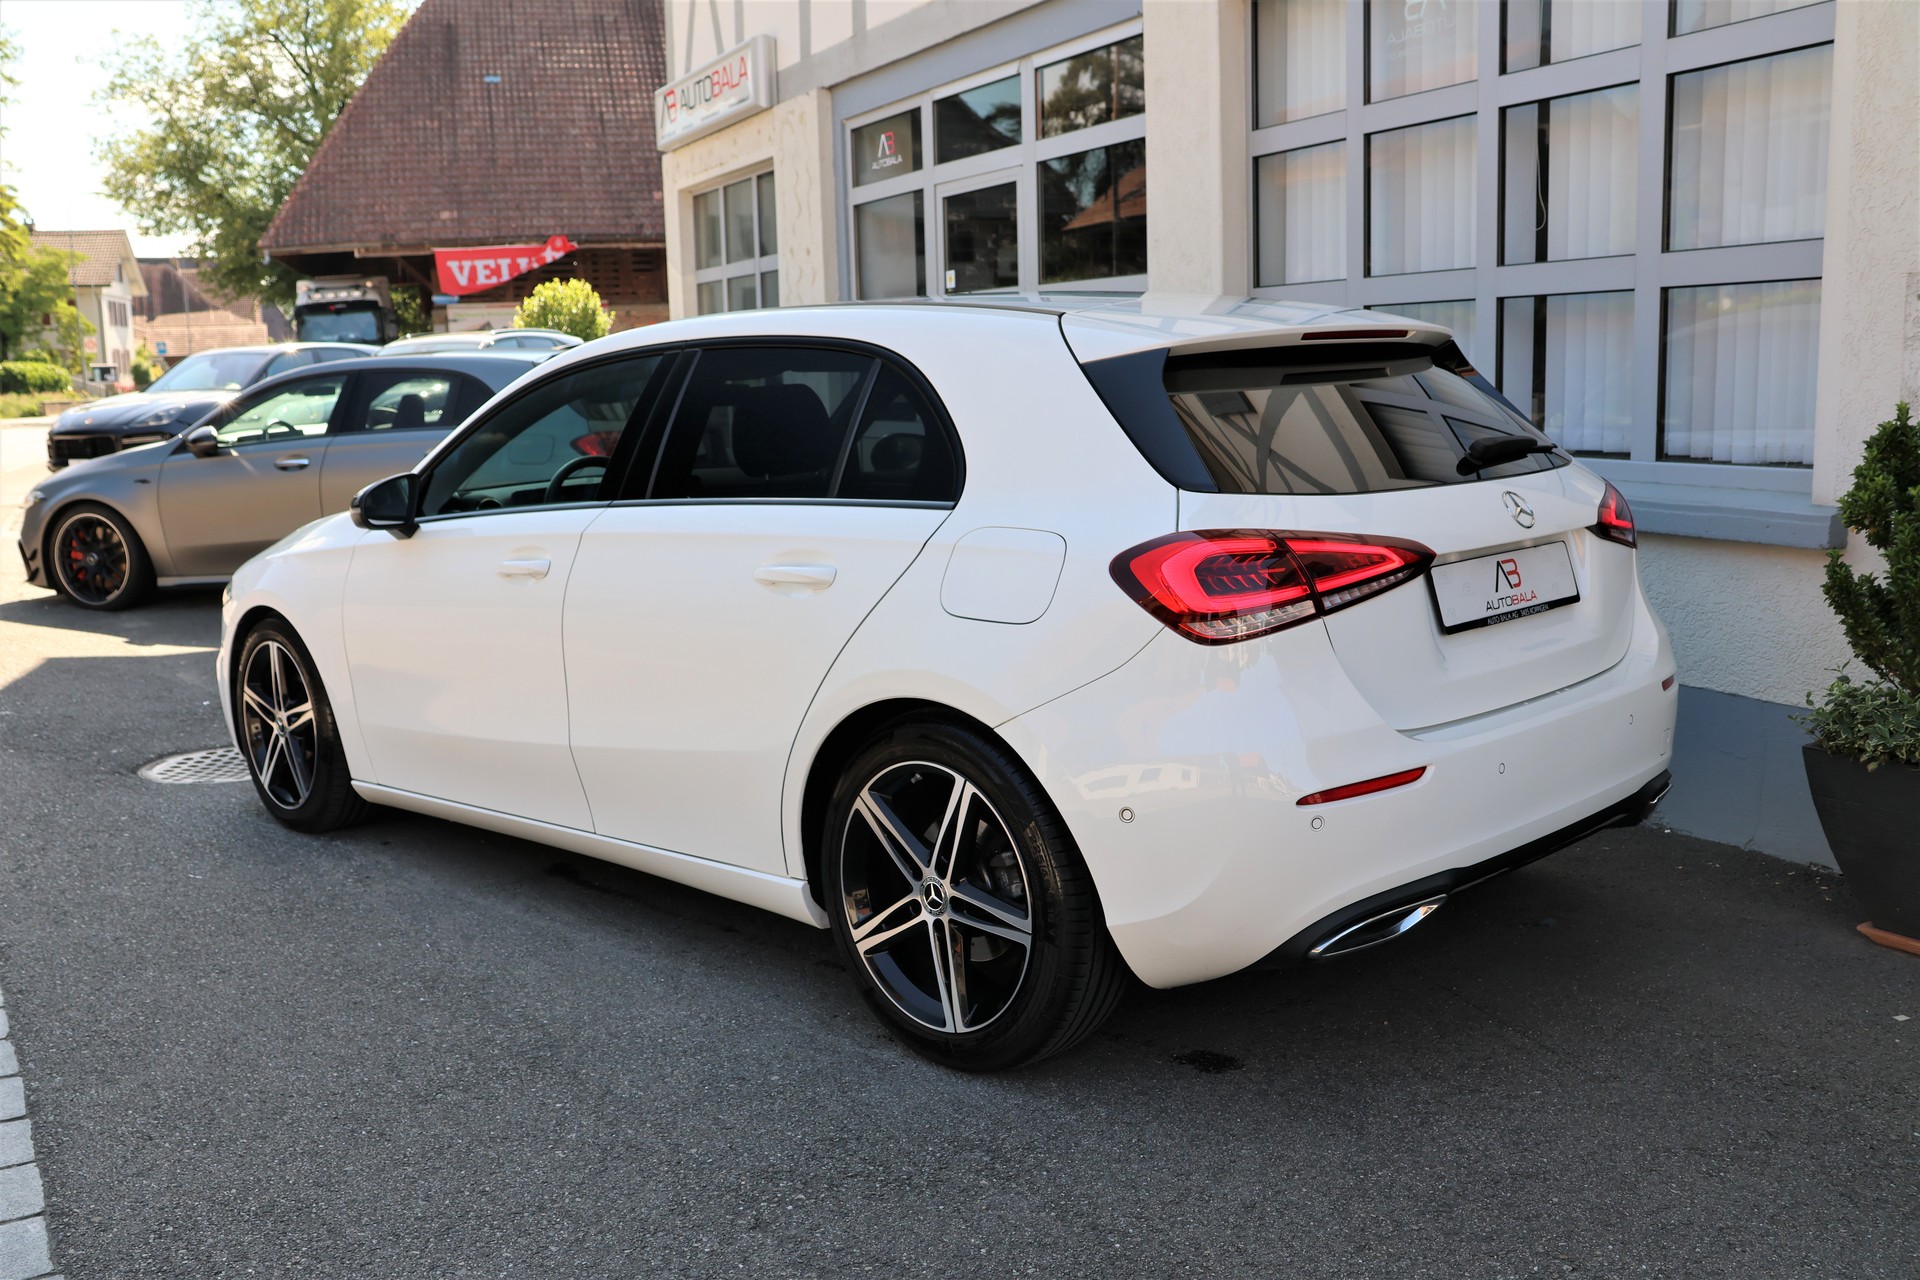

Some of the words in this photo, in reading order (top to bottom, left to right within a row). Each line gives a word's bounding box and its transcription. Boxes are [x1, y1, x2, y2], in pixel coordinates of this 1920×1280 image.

[681, 56, 748, 110] AUTOBALA
[1486, 590, 1537, 612] AUTOBALA
[1487, 615, 1500, 625] AUTO
